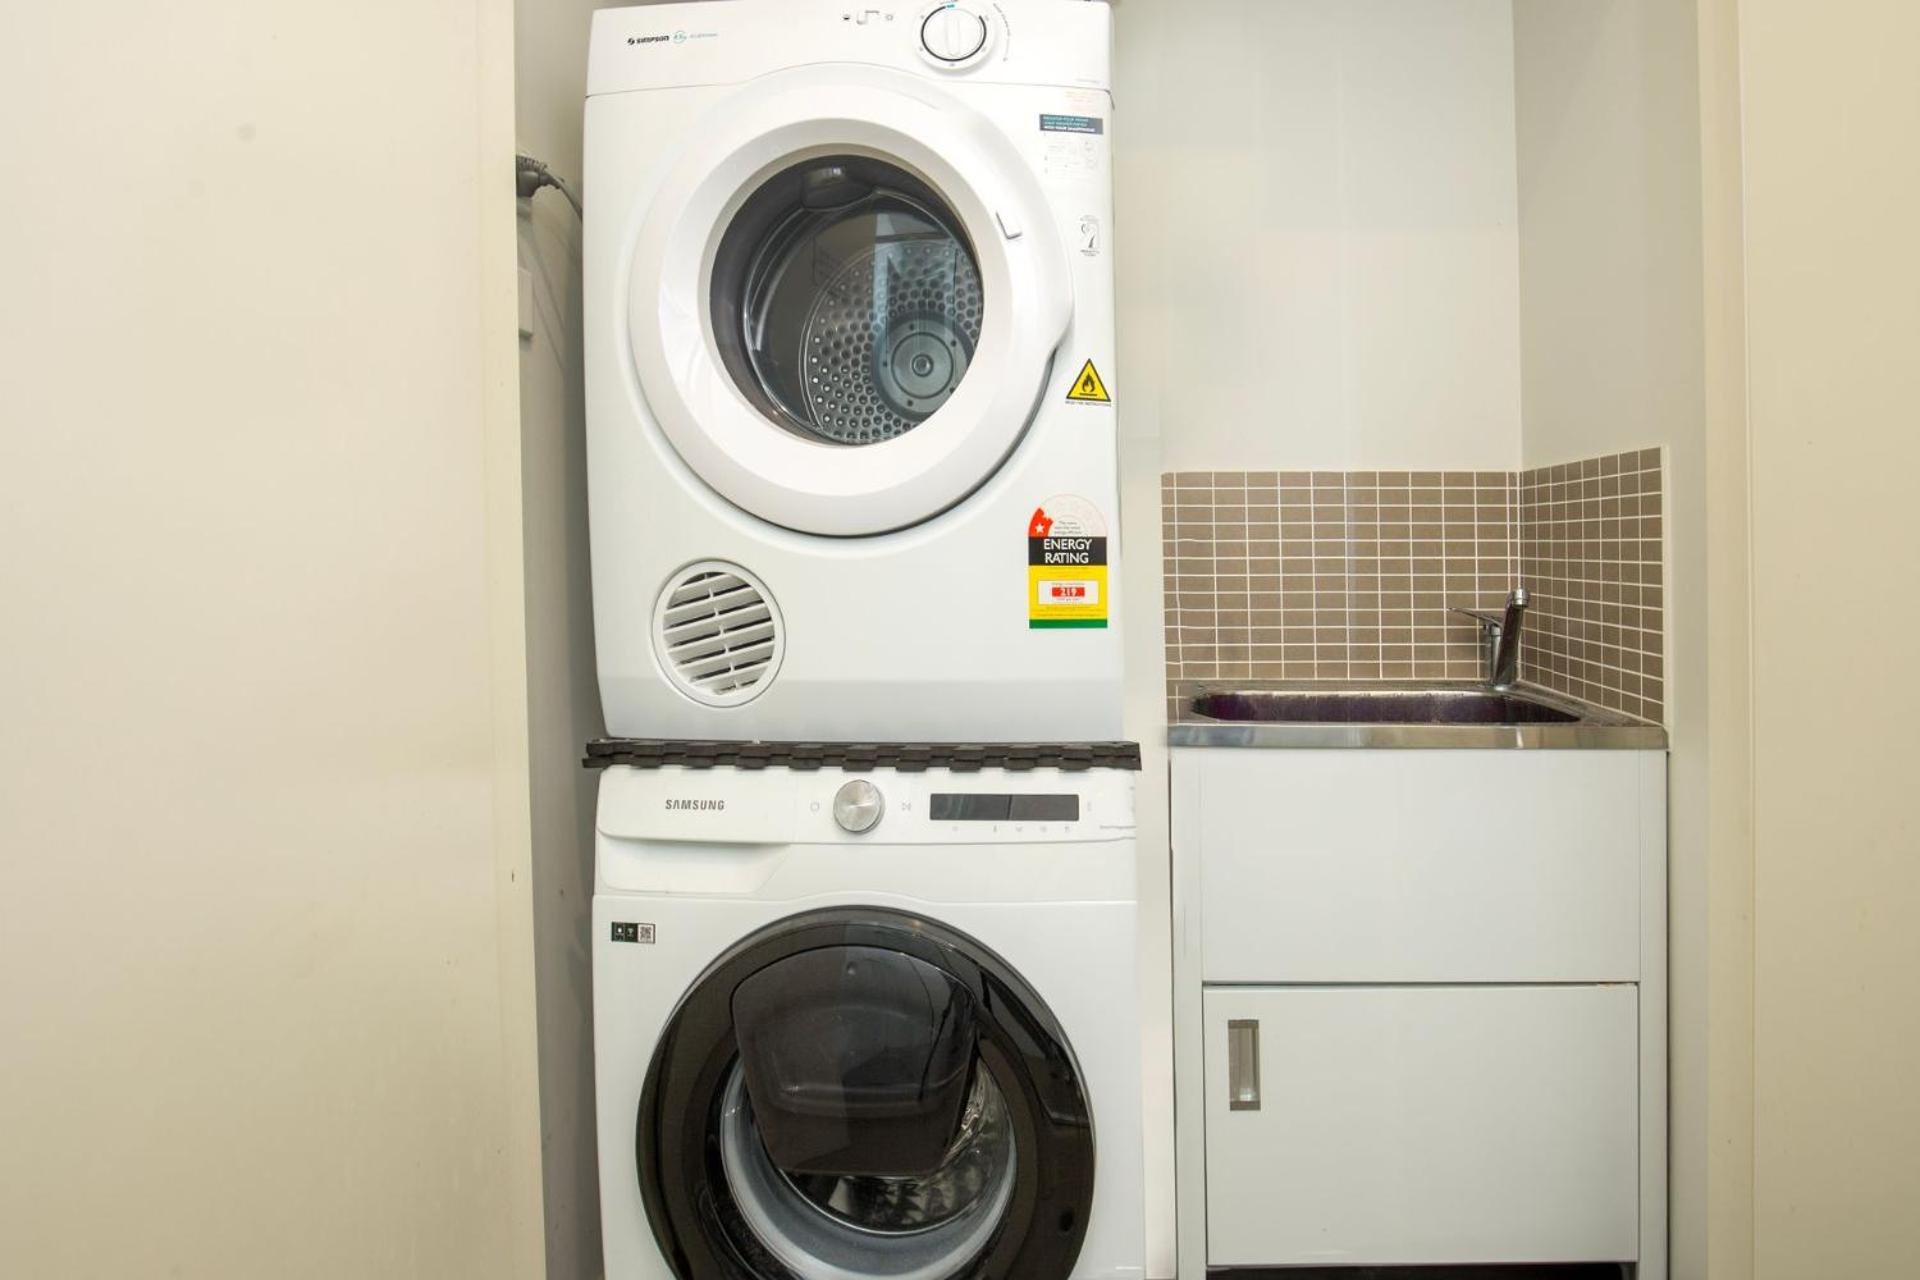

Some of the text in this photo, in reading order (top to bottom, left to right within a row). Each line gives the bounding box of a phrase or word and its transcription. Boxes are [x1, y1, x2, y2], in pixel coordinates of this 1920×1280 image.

[636, 35, 670, 44] SIMPSON
[1043, 538, 1093, 551] ENERGY
[1044, 552, 1090, 564] RATING
[665, 799, 725, 811] SAMSUNG
